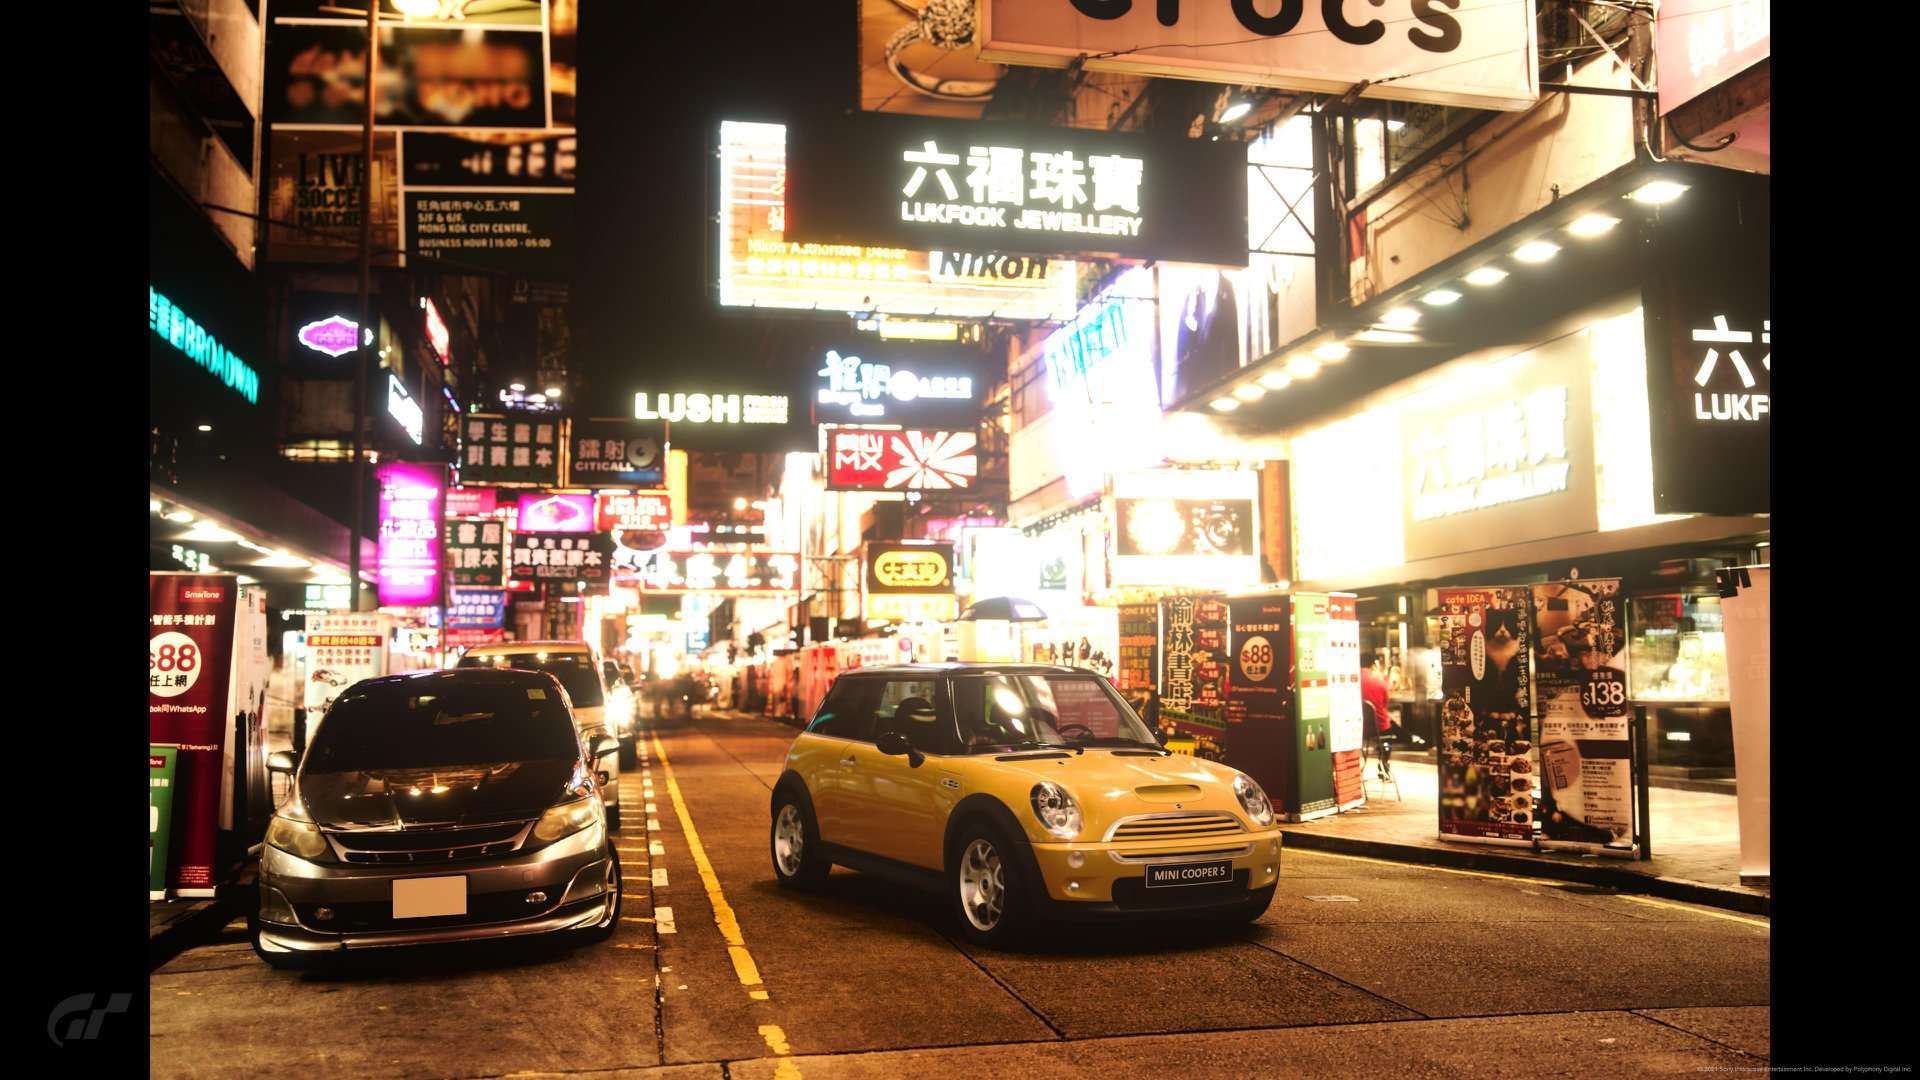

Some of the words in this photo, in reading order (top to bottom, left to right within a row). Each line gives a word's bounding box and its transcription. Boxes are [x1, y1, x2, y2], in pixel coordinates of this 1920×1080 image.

[902, 140, 1144, 214] 六福珠寶
[901, 201, 1006, 228] LUKFOOK
[1013, 209, 1144, 236] JEWELLERY
[418, 223, 447, 233] MONG
[448, 223, 468, 233] KOK
[469, 223, 491, 233] CITY
[418, 238, 461, 248] BUSINESS
[462, 238, 488, 248] HOUR
[184, 316, 259, 405] BROADWAY
[634, 392, 740, 424] LUSH
[575, 461, 635, 473] CITICALL
[184, 590, 220, 599] SmarTone
[1467, 594, 1486, 603] IDEA
[1242, 644, 1272, 664] $88
[1583, 681, 1625, 706] $138
[1154, 869, 1180, 881] MINI
[1181, 867, 1218, 879] COOPER
[1219, 866, 1226, 876] S
